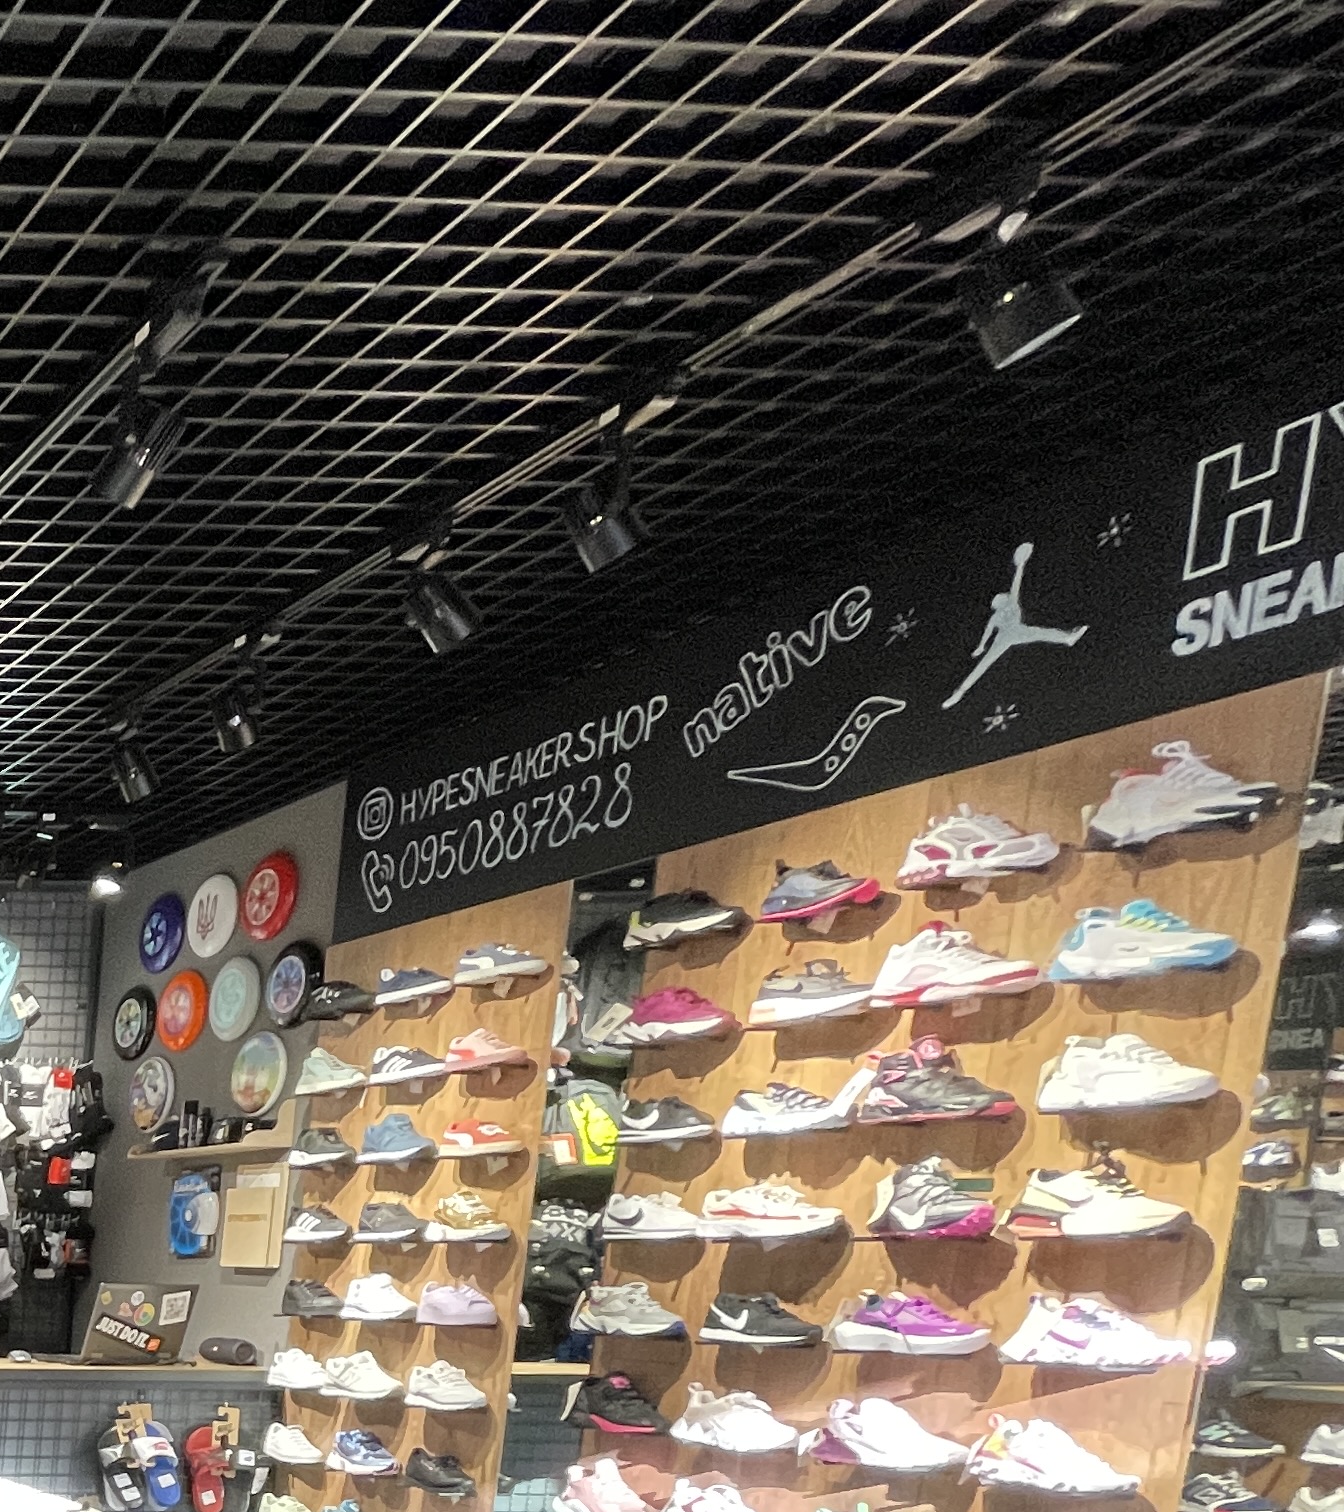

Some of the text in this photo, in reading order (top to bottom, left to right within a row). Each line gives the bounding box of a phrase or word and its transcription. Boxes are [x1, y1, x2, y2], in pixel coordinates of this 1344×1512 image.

[683, 585, 873, 758] native
[399, 694, 669, 826] HYPESNEAKERSHOP
[399, 762, 633, 890] 0950887828
[95, 1316, 125, 1337] JUST
[119, 1325, 139, 1344] DO
